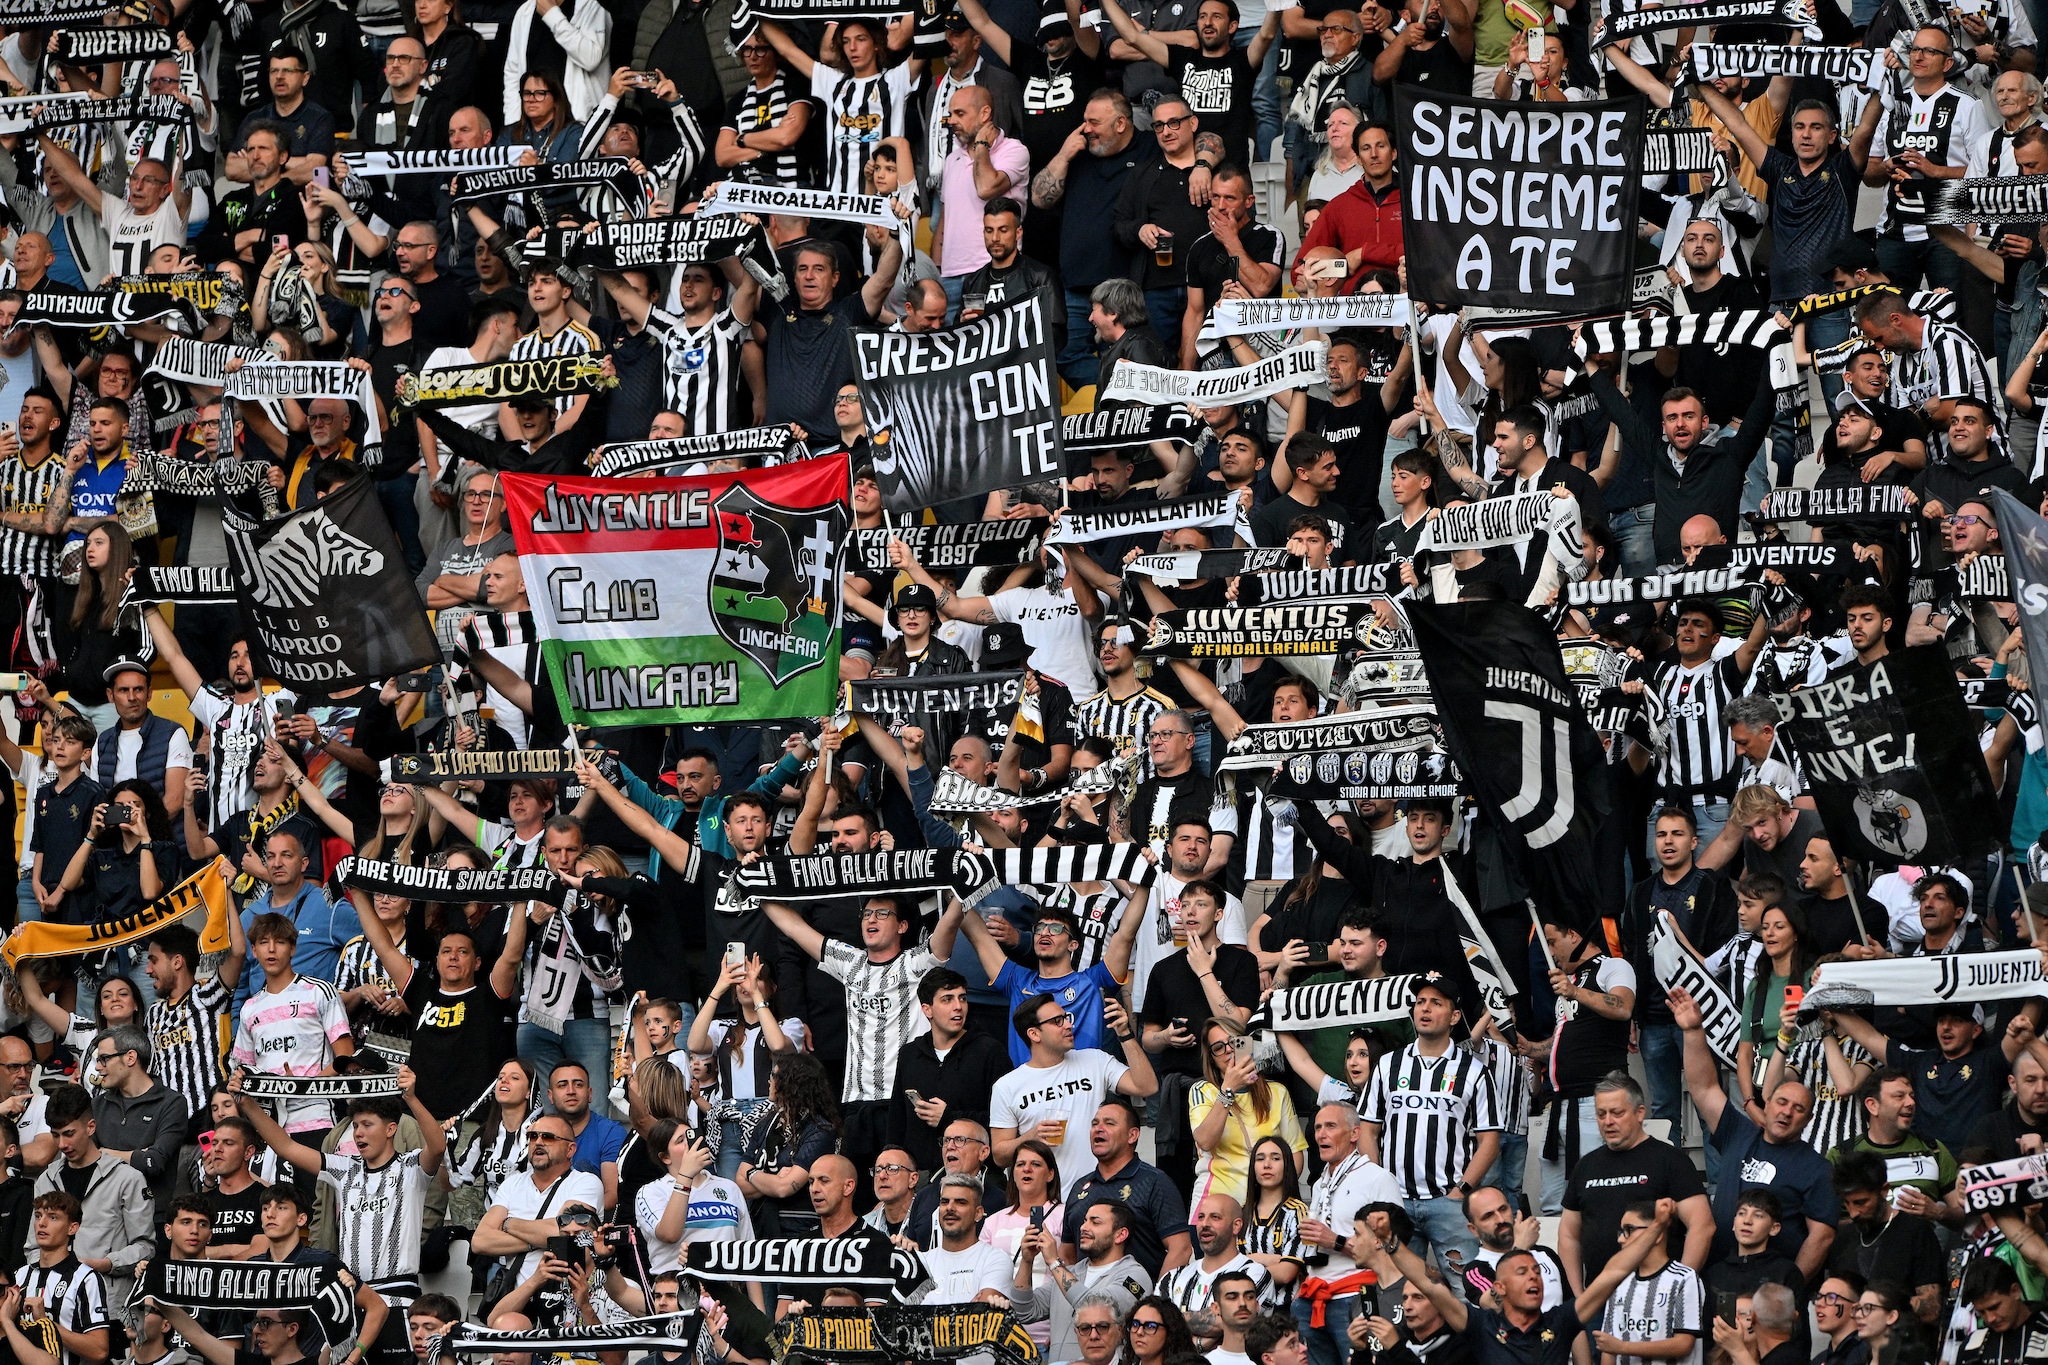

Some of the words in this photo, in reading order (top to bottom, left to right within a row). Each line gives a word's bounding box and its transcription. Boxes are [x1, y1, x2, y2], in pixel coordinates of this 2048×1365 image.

[1615, 0, 1776, 32] #FINOALLAFINE
[67, 30, 171, 58] JUVENTUS
[1698, 44, 1873, 83] JUVENTUS
[37, 104, 73, 126] INO
[1412, 101, 1627, 166] SEMPRE
[1893, 132, 1936, 157] Jeep
[465, 167, 536, 194] JUVENTUS
[727, 189, 884, 216] #FINOALLAFINE
[1411, 165, 1624, 232] INSIEME
[608, 222, 667, 246] PADRE
[670, 220, 692, 241] IN
[695, 218, 753, 240] FIGLIO
[614, 243, 663, 266] SINCE
[666, 240, 709, 262] 1897
[1456, 233, 1492, 292] A
[1509, 236, 1577, 295] TE
[855, 296, 1044, 381] CRESCIUTI
[420, 369, 492, 390] Forza
[484, 360, 579, 399] JUVE
[969, 358, 1050, 422] CON
[1908, 383, 1934, 405] ONY
[1063, 411, 1109, 441] ALLA
[1111, 406, 1154, 436] FINE
[674, 434, 720, 456] CLUB
[724, 428, 787, 451] VARESE
[1012, 421, 1058, 477] TE
[532, 482, 711, 534] JUVENTUS
[1809, 486, 1863, 516] ALLA
[1071, 498, 1226, 534] #FINOALLAFINE
[934, 525, 959, 546] IN
[961, 519, 1031, 545] FIGLIO
[867, 546, 922, 569] SIE
[929, 543, 980, 568] 1897
[1135, 556, 1177, 571] ENTUS
[1727, 547, 1837, 568] JUVENTUS
[150, 567, 193, 592] FINO
[1257, 561, 1389, 602] JUVENTUS
[548, 567, 660, 623] CLUB
[1183, 605, 1349, 632] JUVENTUS
[259, 625, 342, 656] VAPRIO
[739, 627, 821, 661] UNGHERIA
[1175, 632, 1245, 645] BERLINO
[1250, 629, 1353, 643] 06/06/2015
[1191, 641, 1339, 657] #FINOALLAFINALE
[271, 658, 357, 682] D'ADDA
[566, 652, 740, 711] HUNGARY
[861, 679, 1019, 714] JUVENTUS
[1486, 667, 1572, 708] JUVENTUS
[1772, 661, 1894, 722] BIRRA
[1668, 700, 1706, 720] Jeep
[218, 731, 258, 750] Jeep
[987, 720, 1011, 738] Je
[1825, 715, 1856, 747] E
[429, 752, 449, 776] JC
[451, 752, 504, 775] VAPRIO
[506, 750, 560, 775] D'ADDA
[1807, 733, 1916, 783] JUVE!
[1340, 786, 1369, 799] STORIA
[1370, 786, 1379, 798] DI
[1380, 786, 1393, 798] UN
[1394, 785, 1428, 798] GRANDE
[1429, 784, 1458, 797] AMORE
[335, 856, 355, 883] WE
[357, 857, 391, 882] ARE
[392, 865, 453, 890] YOUTH.
[456, 870, 506, 891] SINCE
[508, 869, 557, 892] 1897
[790, 857, 837, 888] FINO
[841, 853, 889, 885] ALLA
[893, 849, 938, 881] FINE
[853, 996, 892, 1015] Jeep
[1282, 975, 1416, 1021] JUVENTUS
[256, 1036, 298, 1053] Jeep
[242, 1081, 252, 1092] #
[258, 1080, 297, 1095] FINO
[305, 1081, 351, 1095] ALLA
[360, 1078, 399, 1094] FINE
[1391, 1094, 1459, 1113] SONY
[484, 1158, 509, 1174] Jee
[1963, 1166, 2006, 1189] AL
[1585, 1175, 1638, 1189] PIACENZA
[350, 1194, 391, 1213] Jeep
[686, 1204, 739, 1220] ANONE
[705, 1238, 871, 1274] JUVENTUS
[165, 1264, 214, 1298] FINO
[218, 1269, 271, 1300] ALLA
[275, 1266, 323, 1299] FINE
[557, 1322, 657, 1340] JUVENTUS
[803, 1316, 824, 1348] DI
[825, 1317, 875, 1350] PADRE
[933, 1315, 951, 1348] IN
[954, 1312, 1005, 1347] FIGLIO
[1619, 1314, 1660, 1336] Jeep
